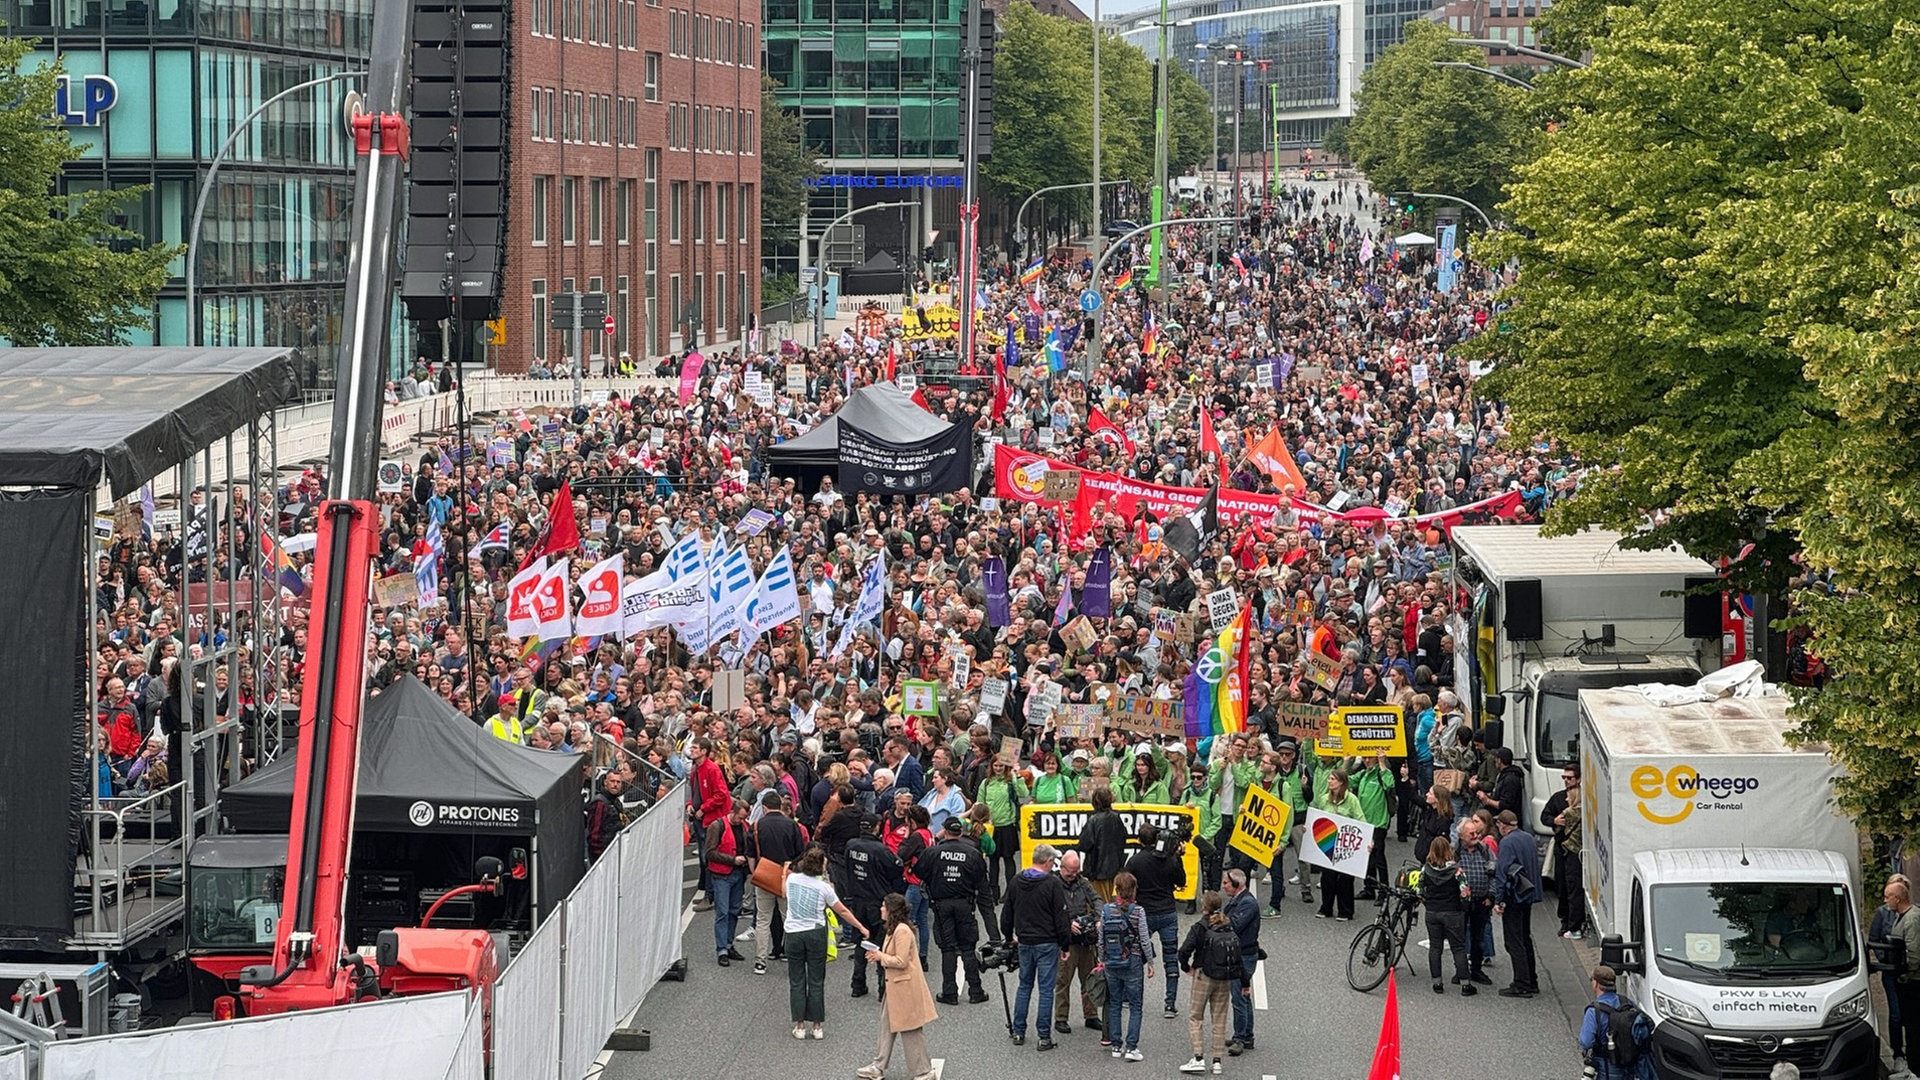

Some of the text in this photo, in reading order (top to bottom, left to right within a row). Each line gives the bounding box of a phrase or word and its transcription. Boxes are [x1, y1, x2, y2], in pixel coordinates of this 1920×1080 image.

[884, 175, 964, 189] EUROPE
[840, 439, 895, 457] GEMEINSAM
[839, 455, 860, 465] UND
[1168, 493, 1204, 505] GEGE
[1212, 592, 1230, 605] OMAS
[1213, 602, 1235, 617] GEGEN
[1213, 613, 1238, 628] RECHTS
[1117, 696, 1184, 719] DEMOKRAT
[1282, 703, 1327, 716] KLIMA-
[1346, 714, 1396, 724] DEMOKRATIE
[1351, 728, 1394, 739] SCHÜTZEN!
[1677, 772, 1759, 795] wheego
[1696, 802, 1743, 810] Car Rental
[438, 805, 519, 822] PROTONES
[1040, 812, 1180, 837] DEMRATIE
[1240, 815, 1277, 849] WAR
[1336, 832, 1363, 852] HERZ
[940, 850, 967, 862] POLIZEI
[263, 917, 273, 935] 8
[1719, 990, 1807, 999] PKW & LKW
[1712, 1000, 1817, 1013] einfach mieten
